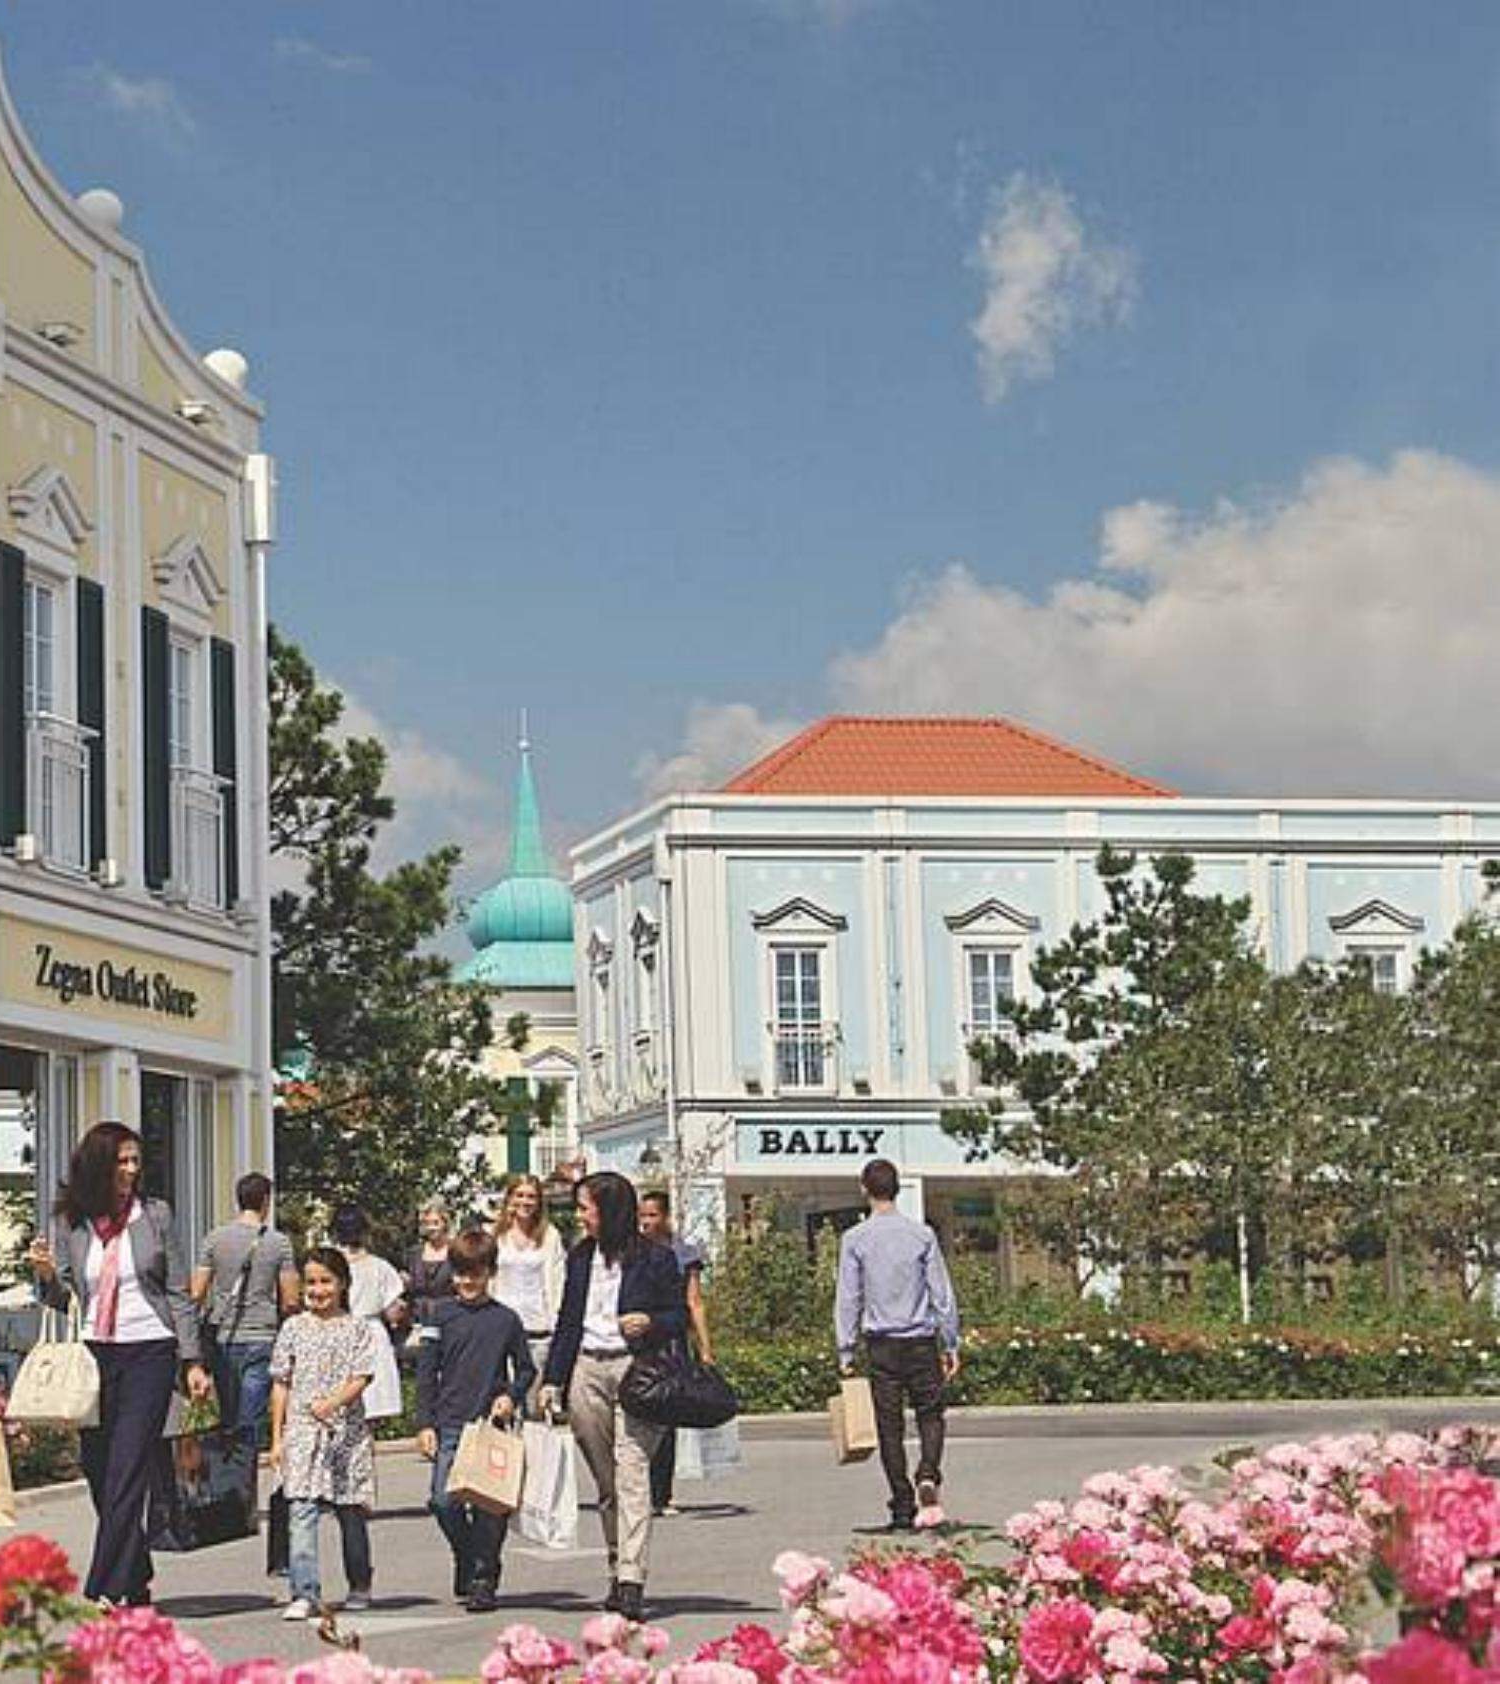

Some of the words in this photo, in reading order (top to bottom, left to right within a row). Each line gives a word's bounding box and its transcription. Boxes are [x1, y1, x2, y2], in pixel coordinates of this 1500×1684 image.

[35, 944, 93, 1003] Zegna
[97, 960, 151, 1008] Outlet
[153, 972, 197, 1018] Store
[759, 1129, 884, 1154] BALLY
